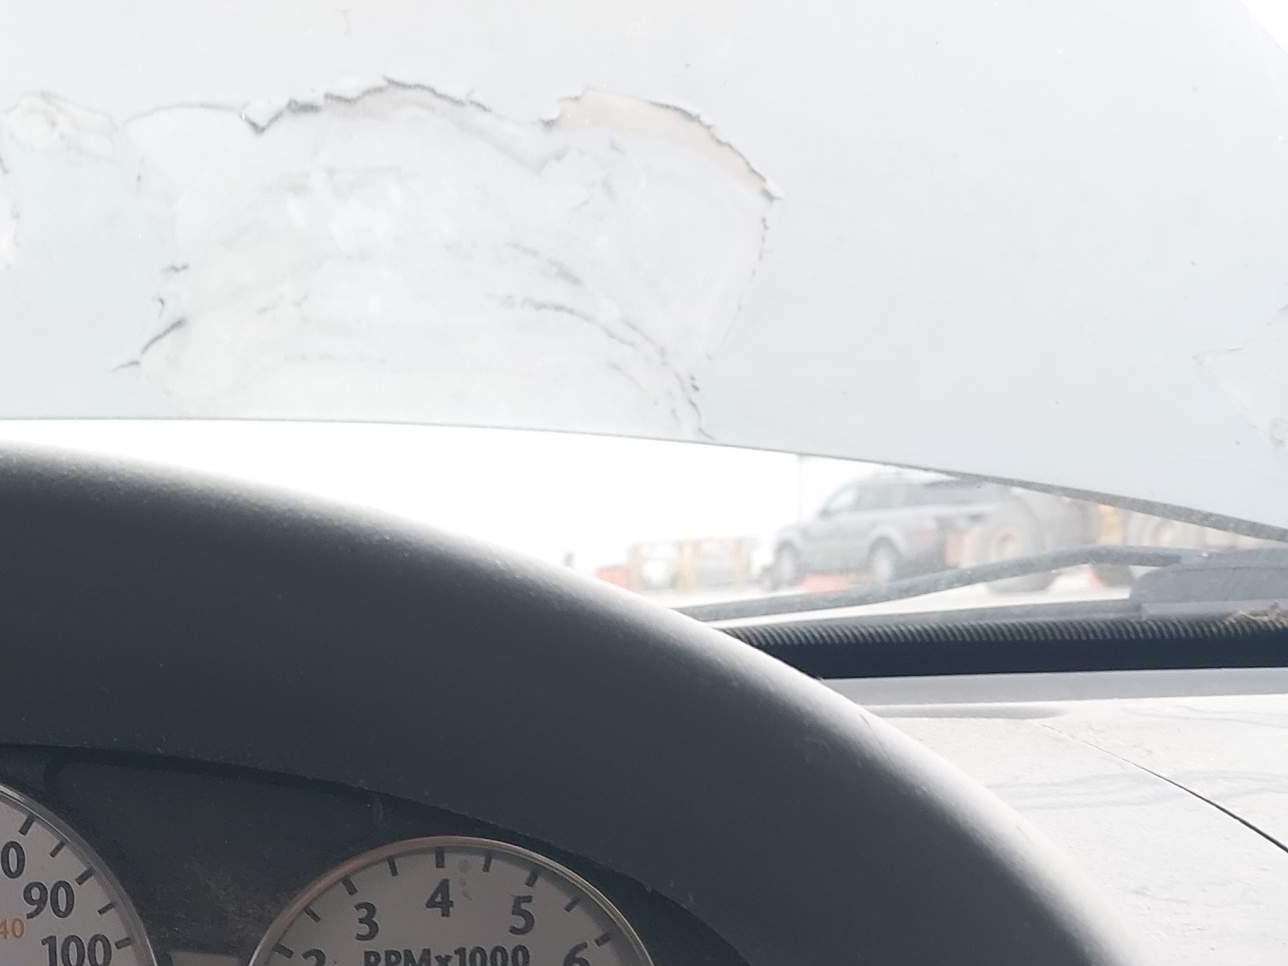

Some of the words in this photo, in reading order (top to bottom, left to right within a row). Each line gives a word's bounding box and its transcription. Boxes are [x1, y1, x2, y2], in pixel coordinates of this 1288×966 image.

[23, 880, 75, 919] 90
[425, 878, 454, 917] 4
[509, 895, 535, 935] 5
[354, 902, 379, 941] 3
